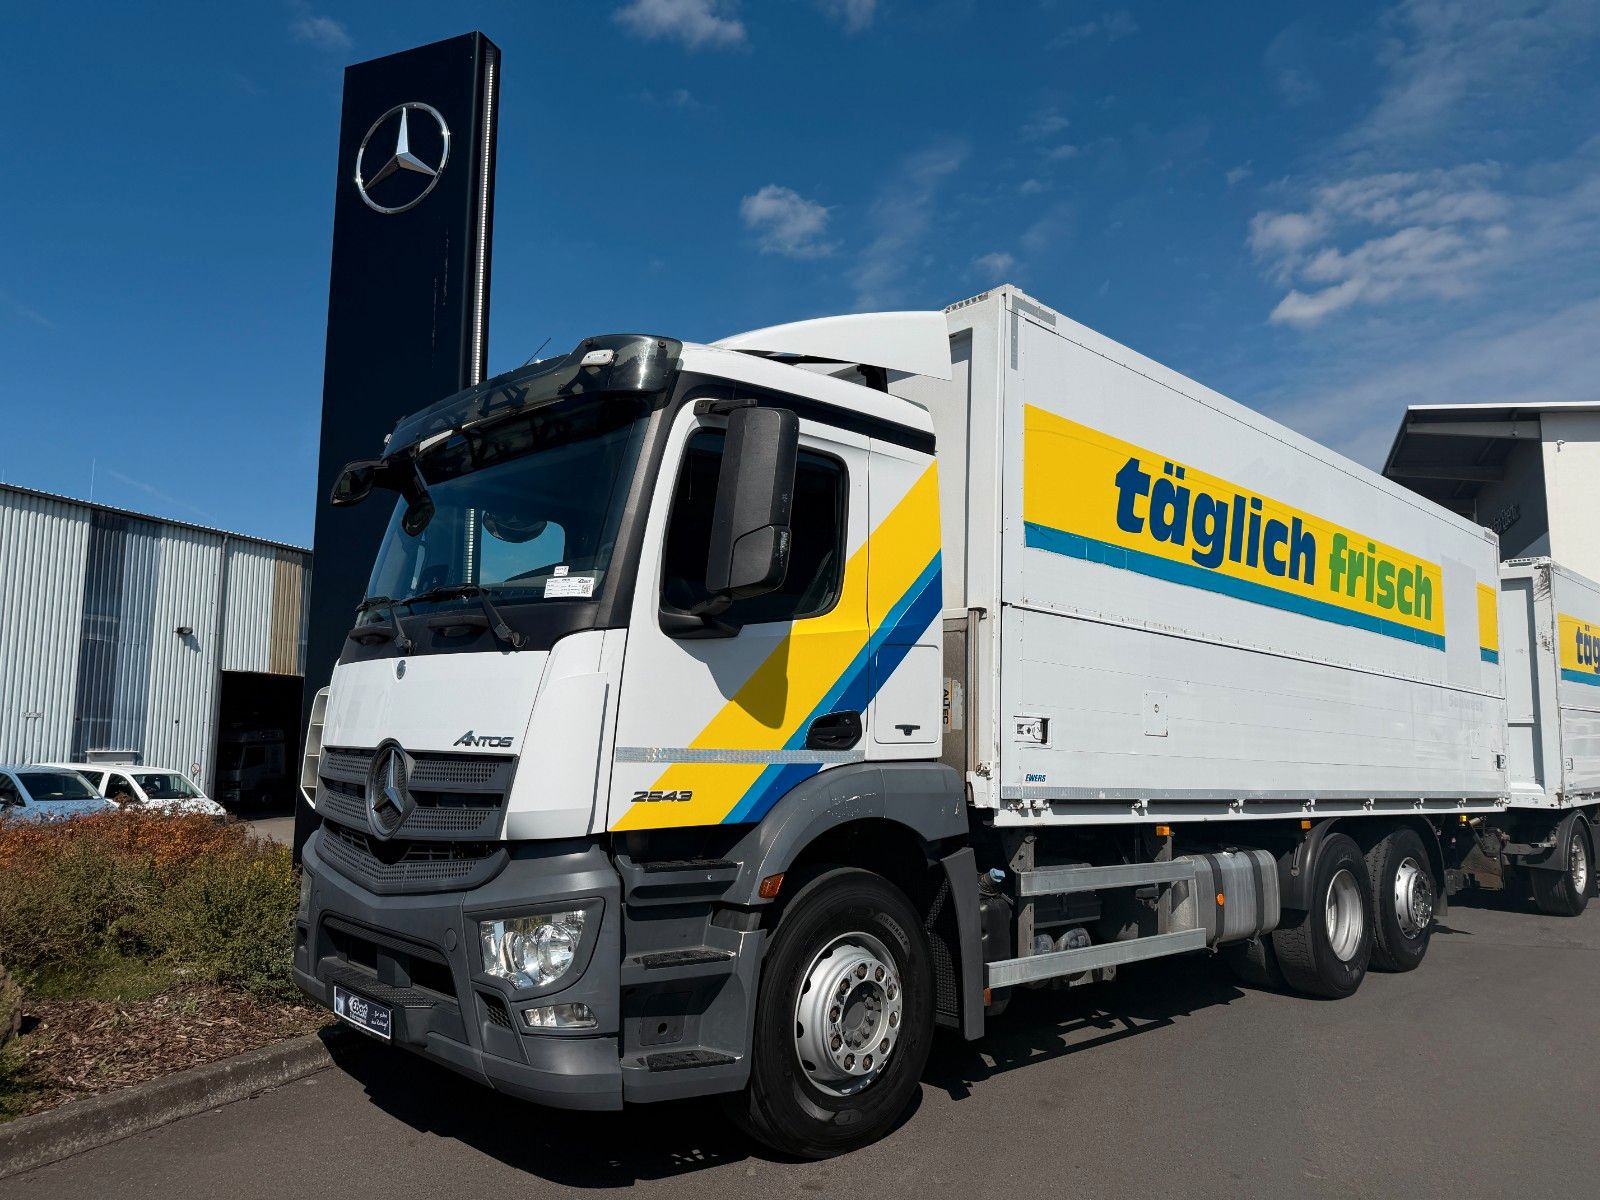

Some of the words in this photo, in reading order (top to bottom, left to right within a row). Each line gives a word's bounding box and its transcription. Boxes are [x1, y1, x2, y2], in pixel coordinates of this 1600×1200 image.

[1115, 457, 1316, 585] täglich
[1329, 532, 1432, 621] frisch
[1025, 773, 1046, 782] EWERS
[631, 790, 693, 803] 2543
